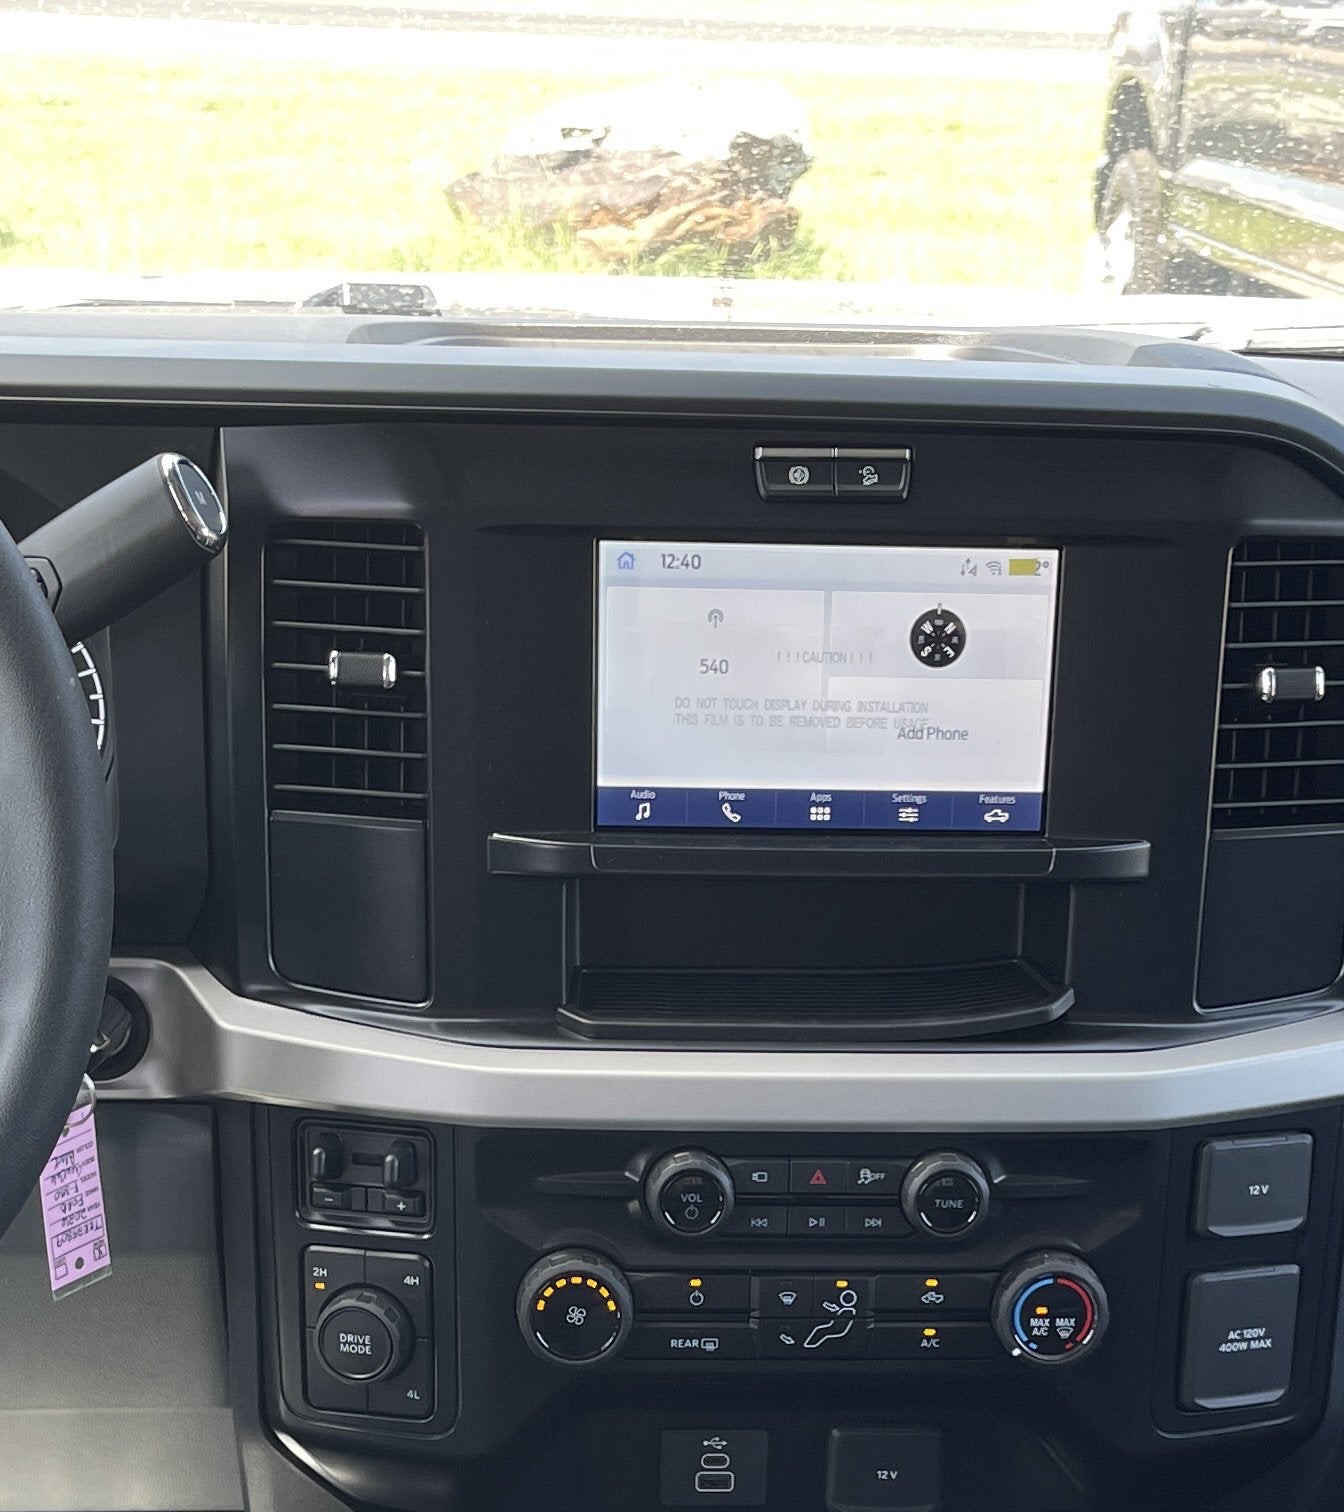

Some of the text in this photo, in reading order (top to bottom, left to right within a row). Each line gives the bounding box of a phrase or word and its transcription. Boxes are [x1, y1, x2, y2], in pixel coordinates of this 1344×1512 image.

[660, 553, 702, 570] 12:40
[699, 658, 730, 675] 540
[675, 697, 929, 714] DO NOT TOUCH DISPLAY DURING INSTALLATION
[675, 713, 698, 725] THIS
[704, 713, 728, 726] FILM
[733, 714, 744, 727] IS
[750, 714, 764, 727] TO
[769, 715, 784, 728] BE
[789, 716, 841, 729] REMOVED
[846, 717, 887, 729] BEFORE
[897, 726, 969, 741] Add Phone
[630, 789, 656, 800] Audio
[718, 790, 746, 801] Phone
[809, 792, 833, 802] Apps
[891, 793, 928, 805] Settings
[978, 794, 1016, 805] Features
[681, 1193, 703, 1204] VOL
[934, 1199, 964, 1210] TUNE
[312, 1267, 328, 1279] 2H
[403, 1275, 420, 1287] 4H
[1030, 1317, 1051, 1327] MAX
[1055, 1317, 1076, 1327] MAX
[1031, 1326, 1049, 1337] A/C
[1228, 1327, 1266, 1341] AC 120V
[339, 1332, 372, 1346] DRIVE
[670, 1338, 700, 1349] REAR
[920, 1338, 941, 1348] A/C
[339, 1343, 372, 1356] MODE
[1219, 1338, 1272, 1353] 400W MAX
[406, 1389, 421, 1401] 4L
